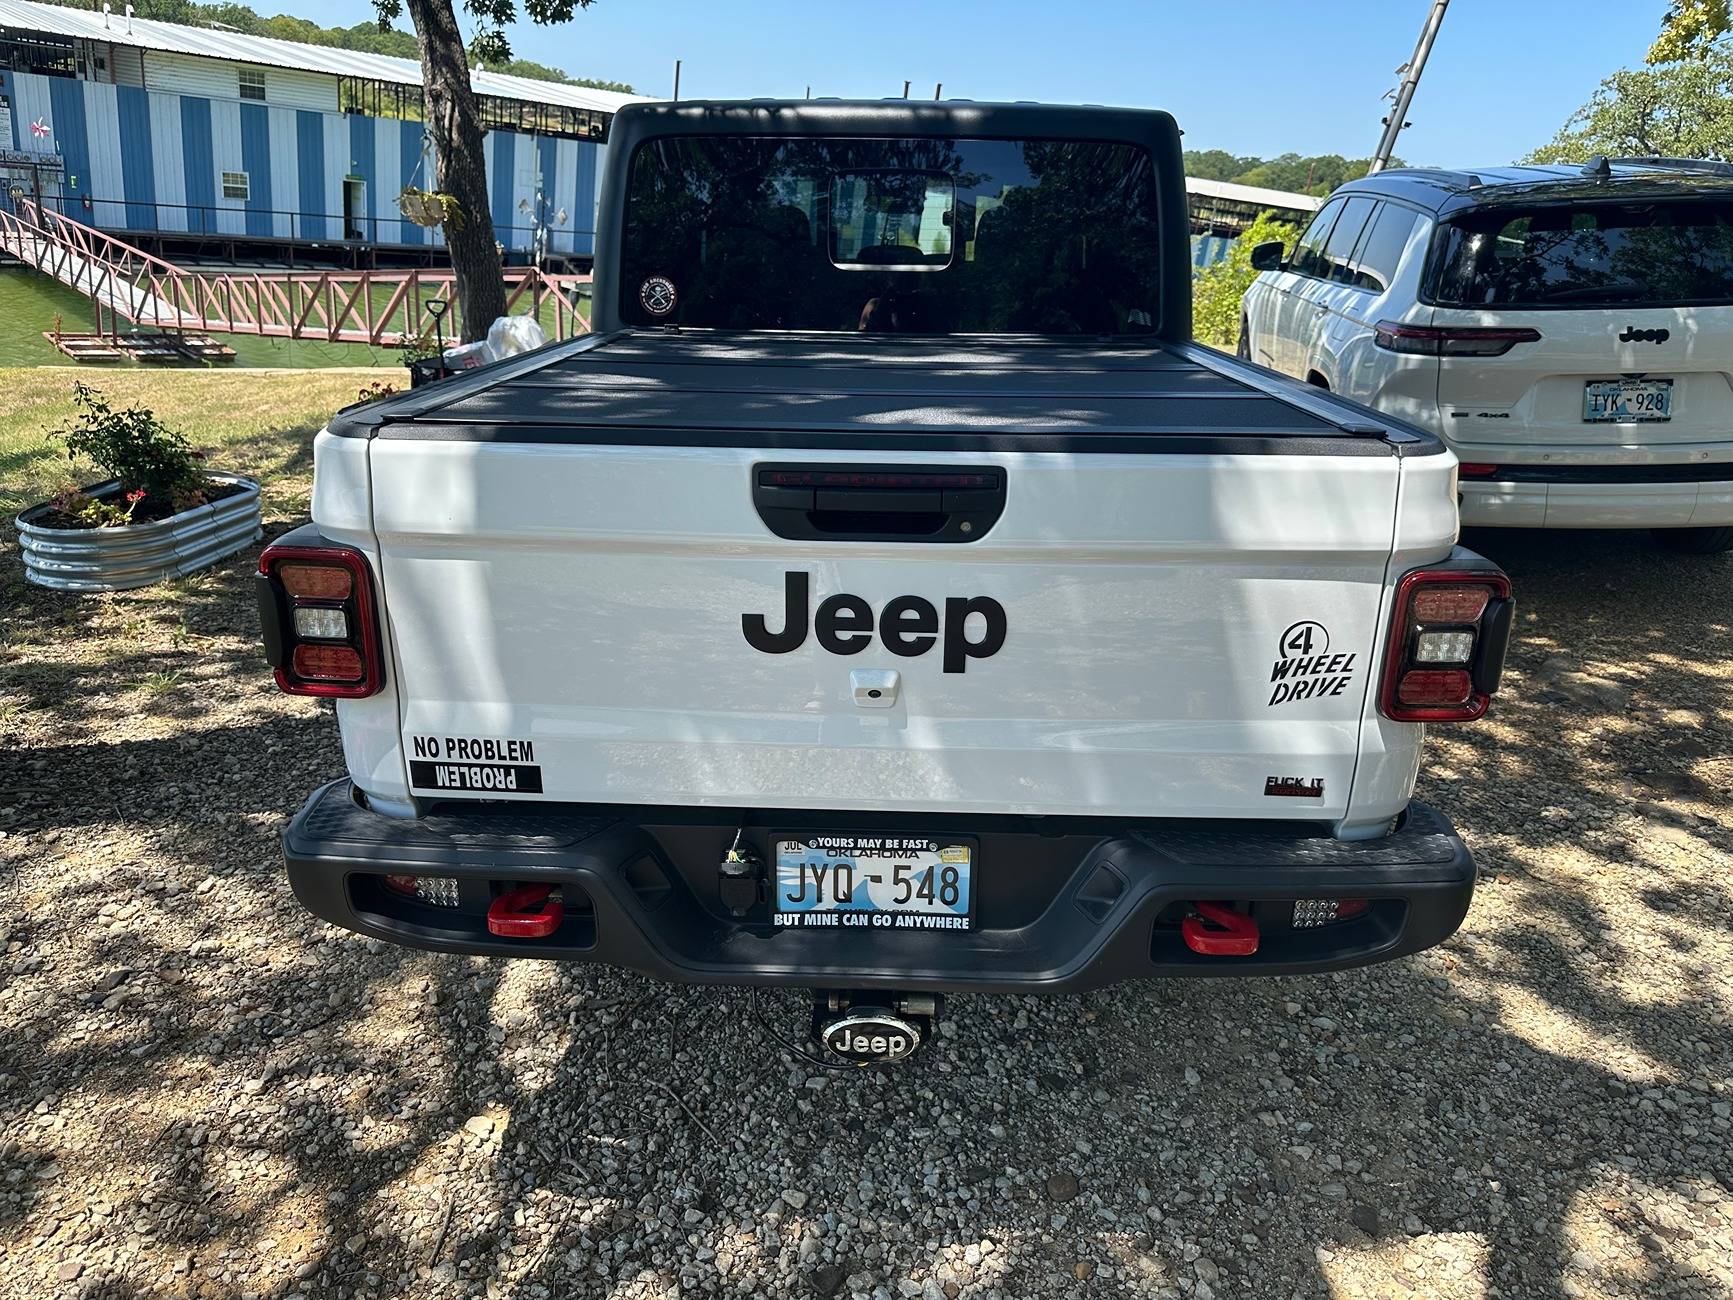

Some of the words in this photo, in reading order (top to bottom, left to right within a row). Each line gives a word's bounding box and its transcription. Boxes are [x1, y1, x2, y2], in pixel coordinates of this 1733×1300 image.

[1619, 326, 1670, 344] Jeep
[741, 571, 1007, 674] Jeep
[1287, 626, 1313, 655] 4
[1270, 653, 1357, 683] WHEEL
[1268, 676, 1352, 707] DRIVE
[413, 736, 440, 758] NO
[445, 737, 535, 762] PROBLEM
[435, 765, 517, 789] PROBLEM
[1311, 778, 1324, 788] IT
[785, 842, 802, 850] JUL
[817, 838, 854, 848] YOURS
[858, 838, 883, 848] MAY
[885, 839, 901, 849] BE
[903, 839, 929, 849] FAST
[826, 850, 920, 859] OKLAHOMA
[774, 914, 800, 926] BUT
[804, 914, 839, 926] MINE
[842, 914, 869, 926] CAN
[872, 915, 892, 927] GO
[895, 915, 970, 930] ANYWHERE
[835, 1029, 906, 1057] Jeep
